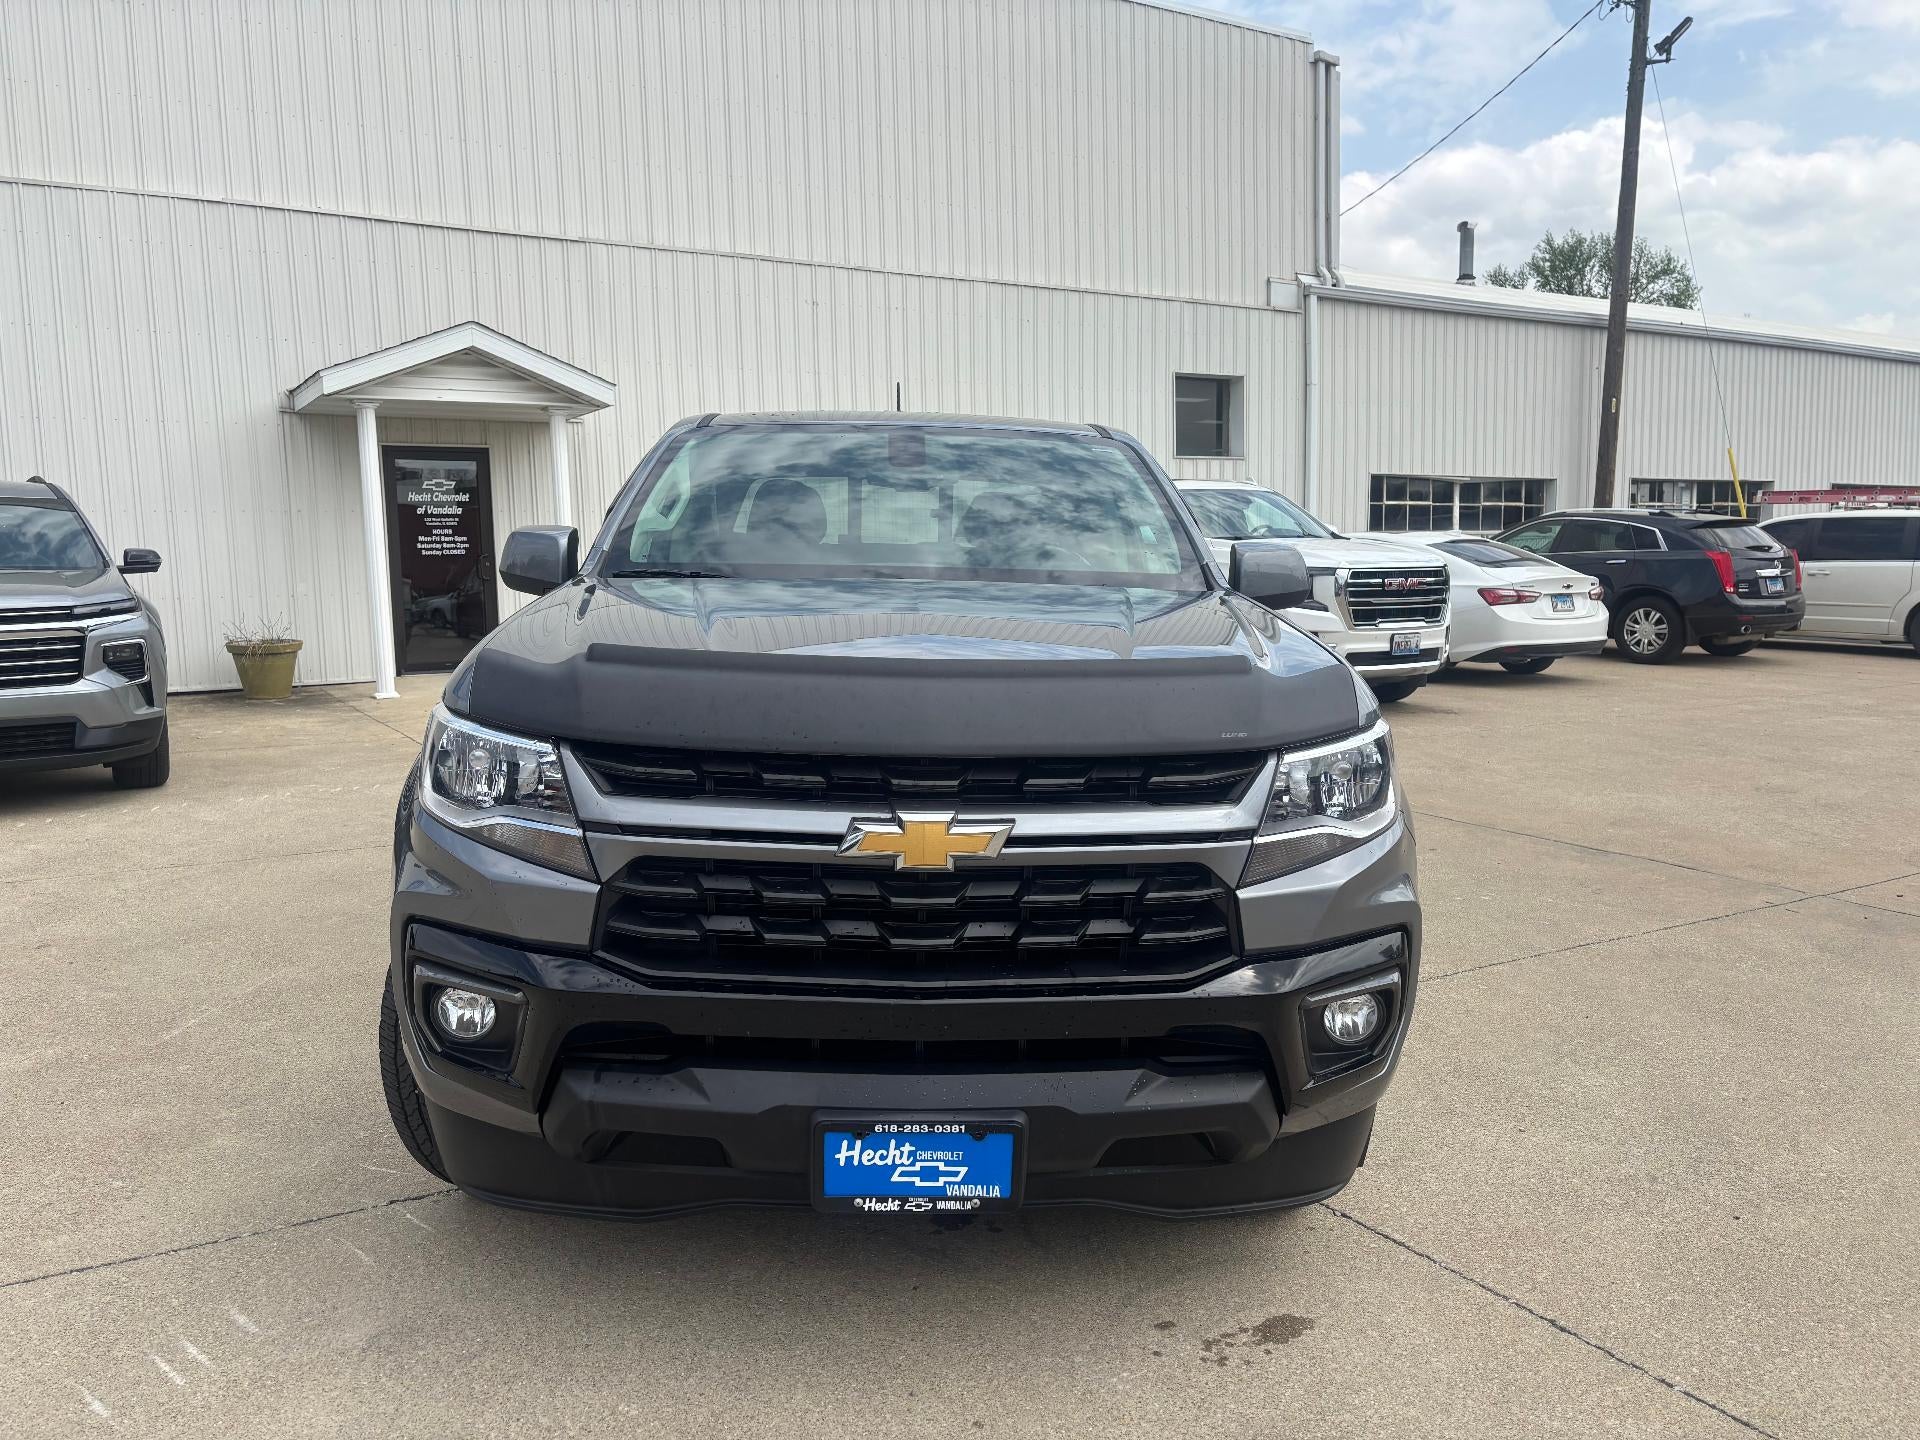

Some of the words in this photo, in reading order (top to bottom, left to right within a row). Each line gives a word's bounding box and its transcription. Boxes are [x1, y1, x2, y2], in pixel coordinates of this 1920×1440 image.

[407, 491, 431, 502] Hecht
[433, 492, 470, 502] Chevrolet
[416, 505, 426, 515] of
[427, 505, 463, 515] Vandalia
[1384, 577, 1427, 590] GMC
[874, 1124, 966, 1133] 618-283-0381
[834, 1138, 916, 1167] Hecht
[916, 1150, 964, 1161] CHEVROLET
[945, 1183, 1001, 1198] VANDALIA
[862, 1197, 902, 1212] Hecht
[936, 1200, 972, 1210] VANDALIA
